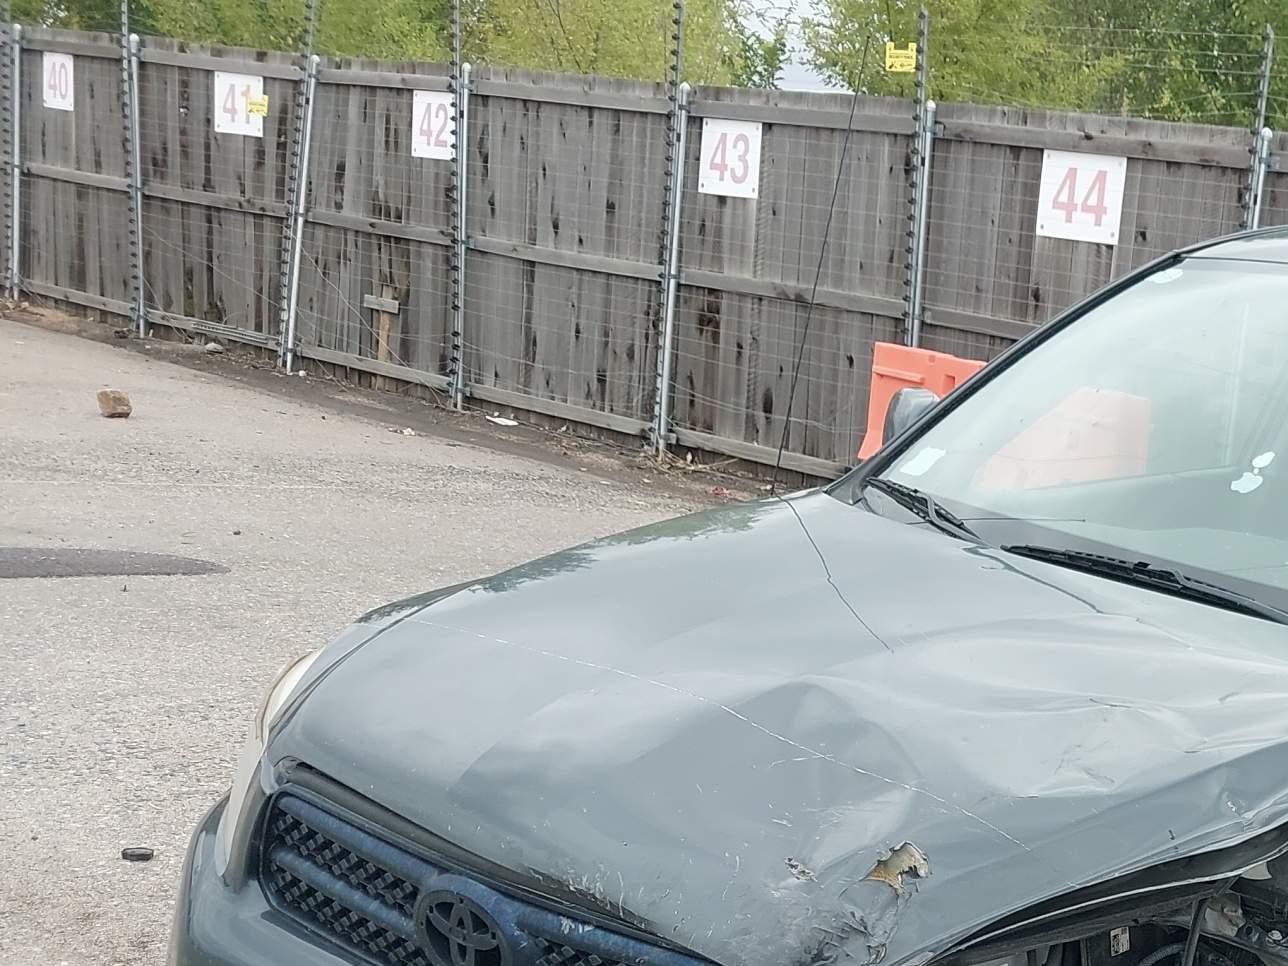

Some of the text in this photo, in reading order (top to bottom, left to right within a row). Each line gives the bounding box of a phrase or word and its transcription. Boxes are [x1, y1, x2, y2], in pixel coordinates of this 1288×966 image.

[48, 61, 68, 100] 40
[223, 83, 251, 124] 41
[419, 102, 448, 148] 42
[709, 132, 750, 184] 43
[1051, 167, 1108, 227] 44
